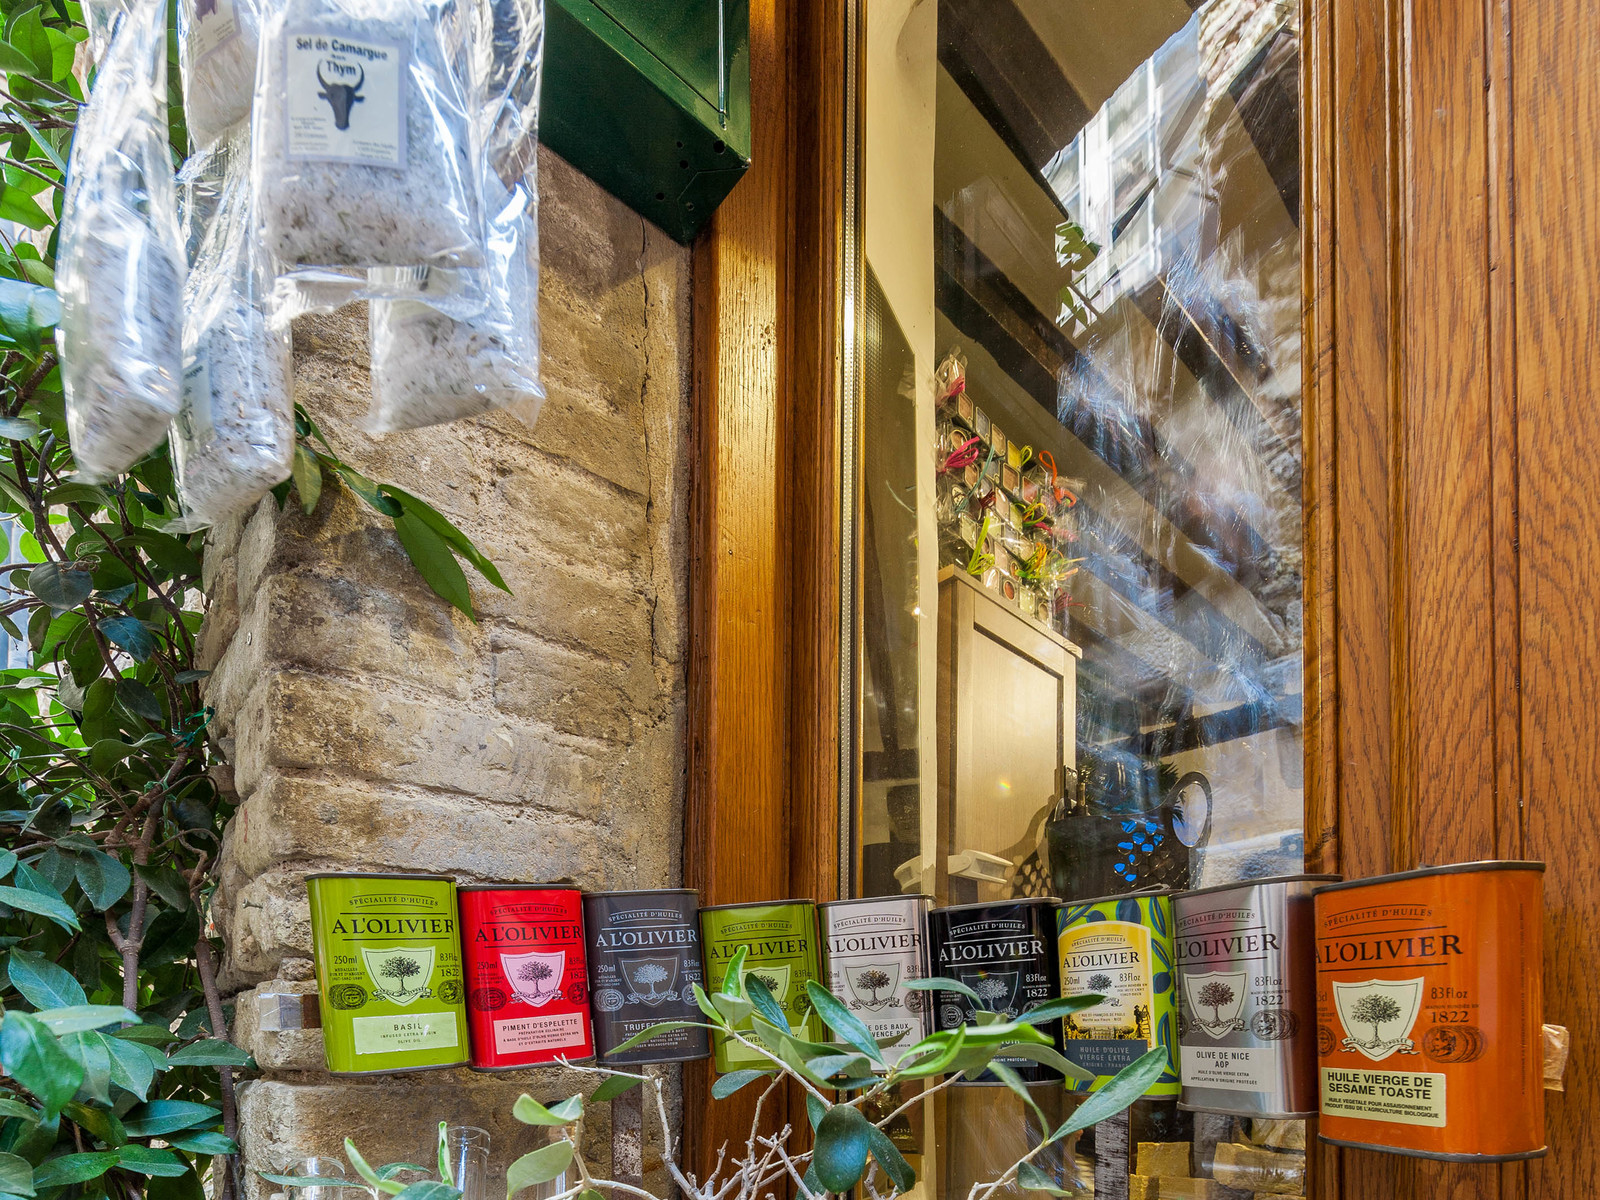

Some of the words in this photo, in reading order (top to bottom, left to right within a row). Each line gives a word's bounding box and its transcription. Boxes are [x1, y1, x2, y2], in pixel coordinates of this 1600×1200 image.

[296, 38, 312, 49] Sel
[316, 40, 328, 49] de
[332, 40, 387, 60] Camargue
[326, 61, 356, 77] Thym
[349, 896, 398, 906] SPÉCIALITÉ
[399, 897, 439, 906] D'HUILES
[609, 912, 648, 922] SPÉCIALITÉ
[651, 911, 682, 919] D'HUILES
[1219, 911, 1255, 919] D'HUILES
[1324, 911, 1378, 927] SPÉCIALITÉ
[1382, 909, 1432, 917] D'HUILES
[332, 920, 347, 934] A
[353, 918, 454, 934] L'OLIVIER
[721, 924, 758, 934] SPÉCIALITÉ
[950, 924, 988, 935] SPÉCIALITÉ
[475, 928, 489, 942] A
[493, 926, 582, 941] L'OLIVIER
[596, 936, 606, 947] A
[611, 930, 697, 946] L'OLIVIER
[835, 935, 921, 951] L'OLIVIER
[1177, 933, 1279, 960] L'OLIVIER
[1325, 934, 1464, 963] L'OLIVIER
[710, 947, 720, 959] A
[940, 949, 948, 962] A
[951, 941, 1044, 960] L'OLIVIER
[334, 955, 358, 964] 250ml
[1063, 956, 1071, 968] A
[1073, 952, 1140, 967] L'OLIVIER
[441, 969, 459, 977] 1822
[684, 973, 701, 981] 1822
[1026, 988, 1048, 997] 1822
[1255, 996, 1283, 1006] 1822
[1432, 1011, 1469, 1023] 1822
[394, 1023, 422, 1031] BASIL
[533, 1019, 577, 1028] D'ESPELETTE
[1328, 1072, 1360, 1083] HUILE
[1363, 1074, 1409, 1086] VIERGE
[1414, 1077, 1432, 1087] DE
[1329, 1083, 1375, 1095] SESAME
[1379, 1087, 1431, 1099] TOASTE
[1364, 1106, 1403, 1115] L'AGRICULTURE
[1383, 1102, 1432, 1111] ASSAISONNEMENT
